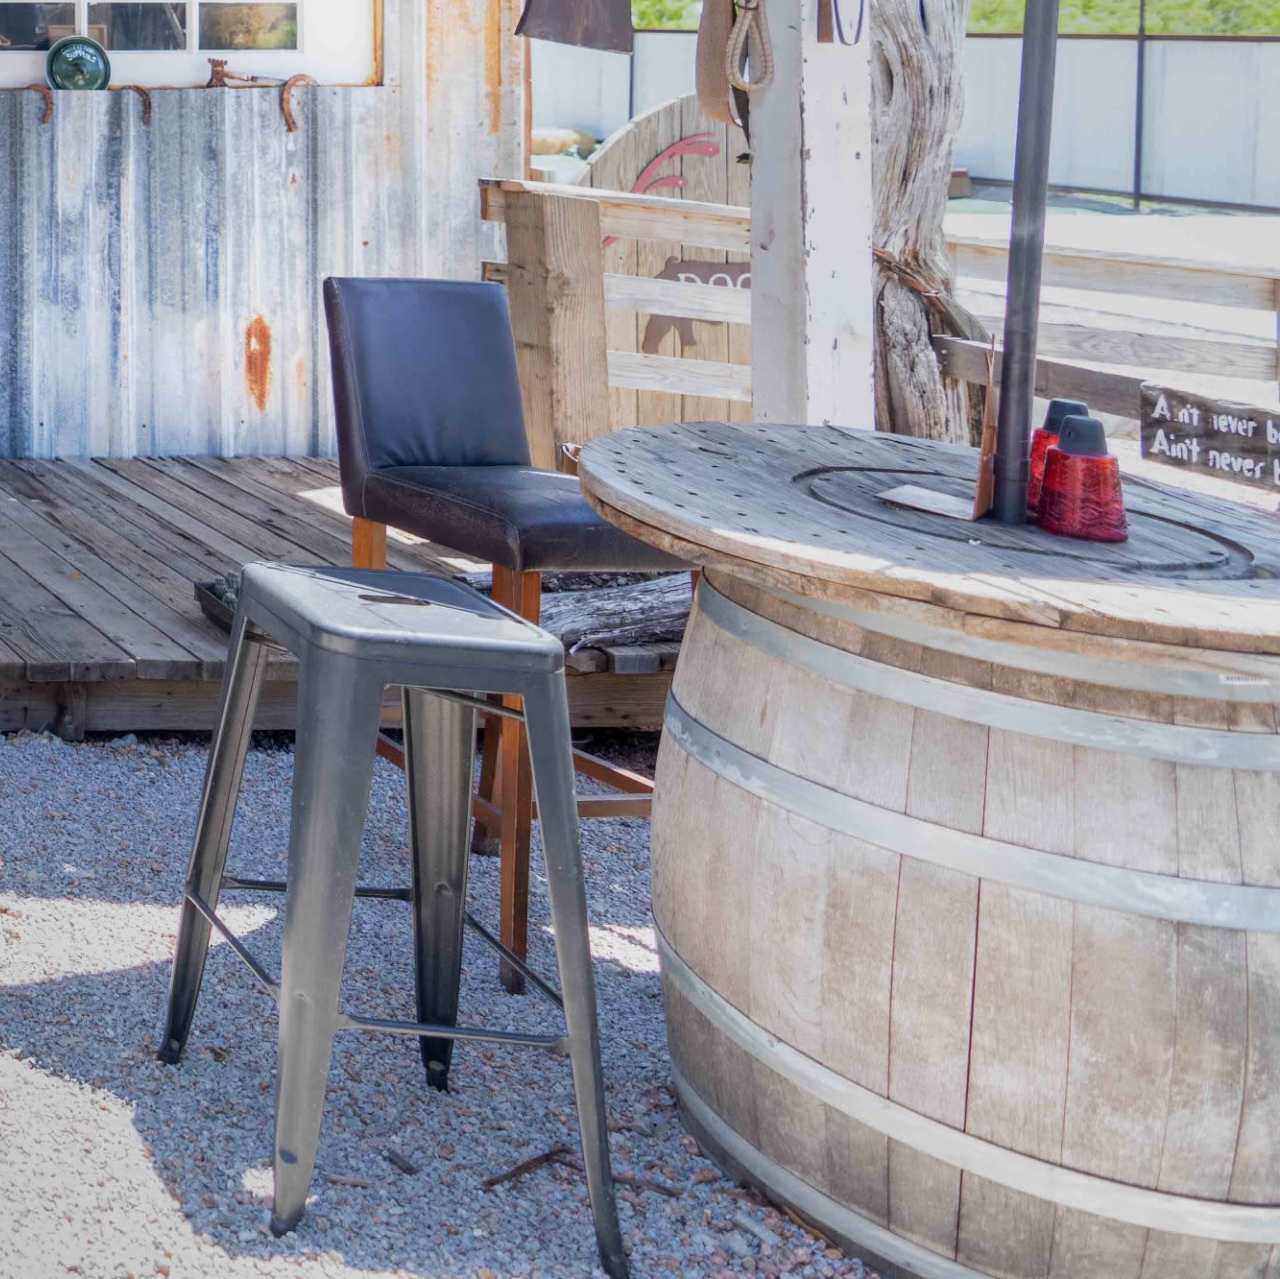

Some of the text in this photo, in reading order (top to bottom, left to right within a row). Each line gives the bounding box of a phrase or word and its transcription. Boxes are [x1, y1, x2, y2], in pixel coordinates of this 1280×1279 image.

[1151, 393, 1200, 426] An't
[1149, 428, 1200, 463] Ain't
[1208, 449, 1265, 479] never
